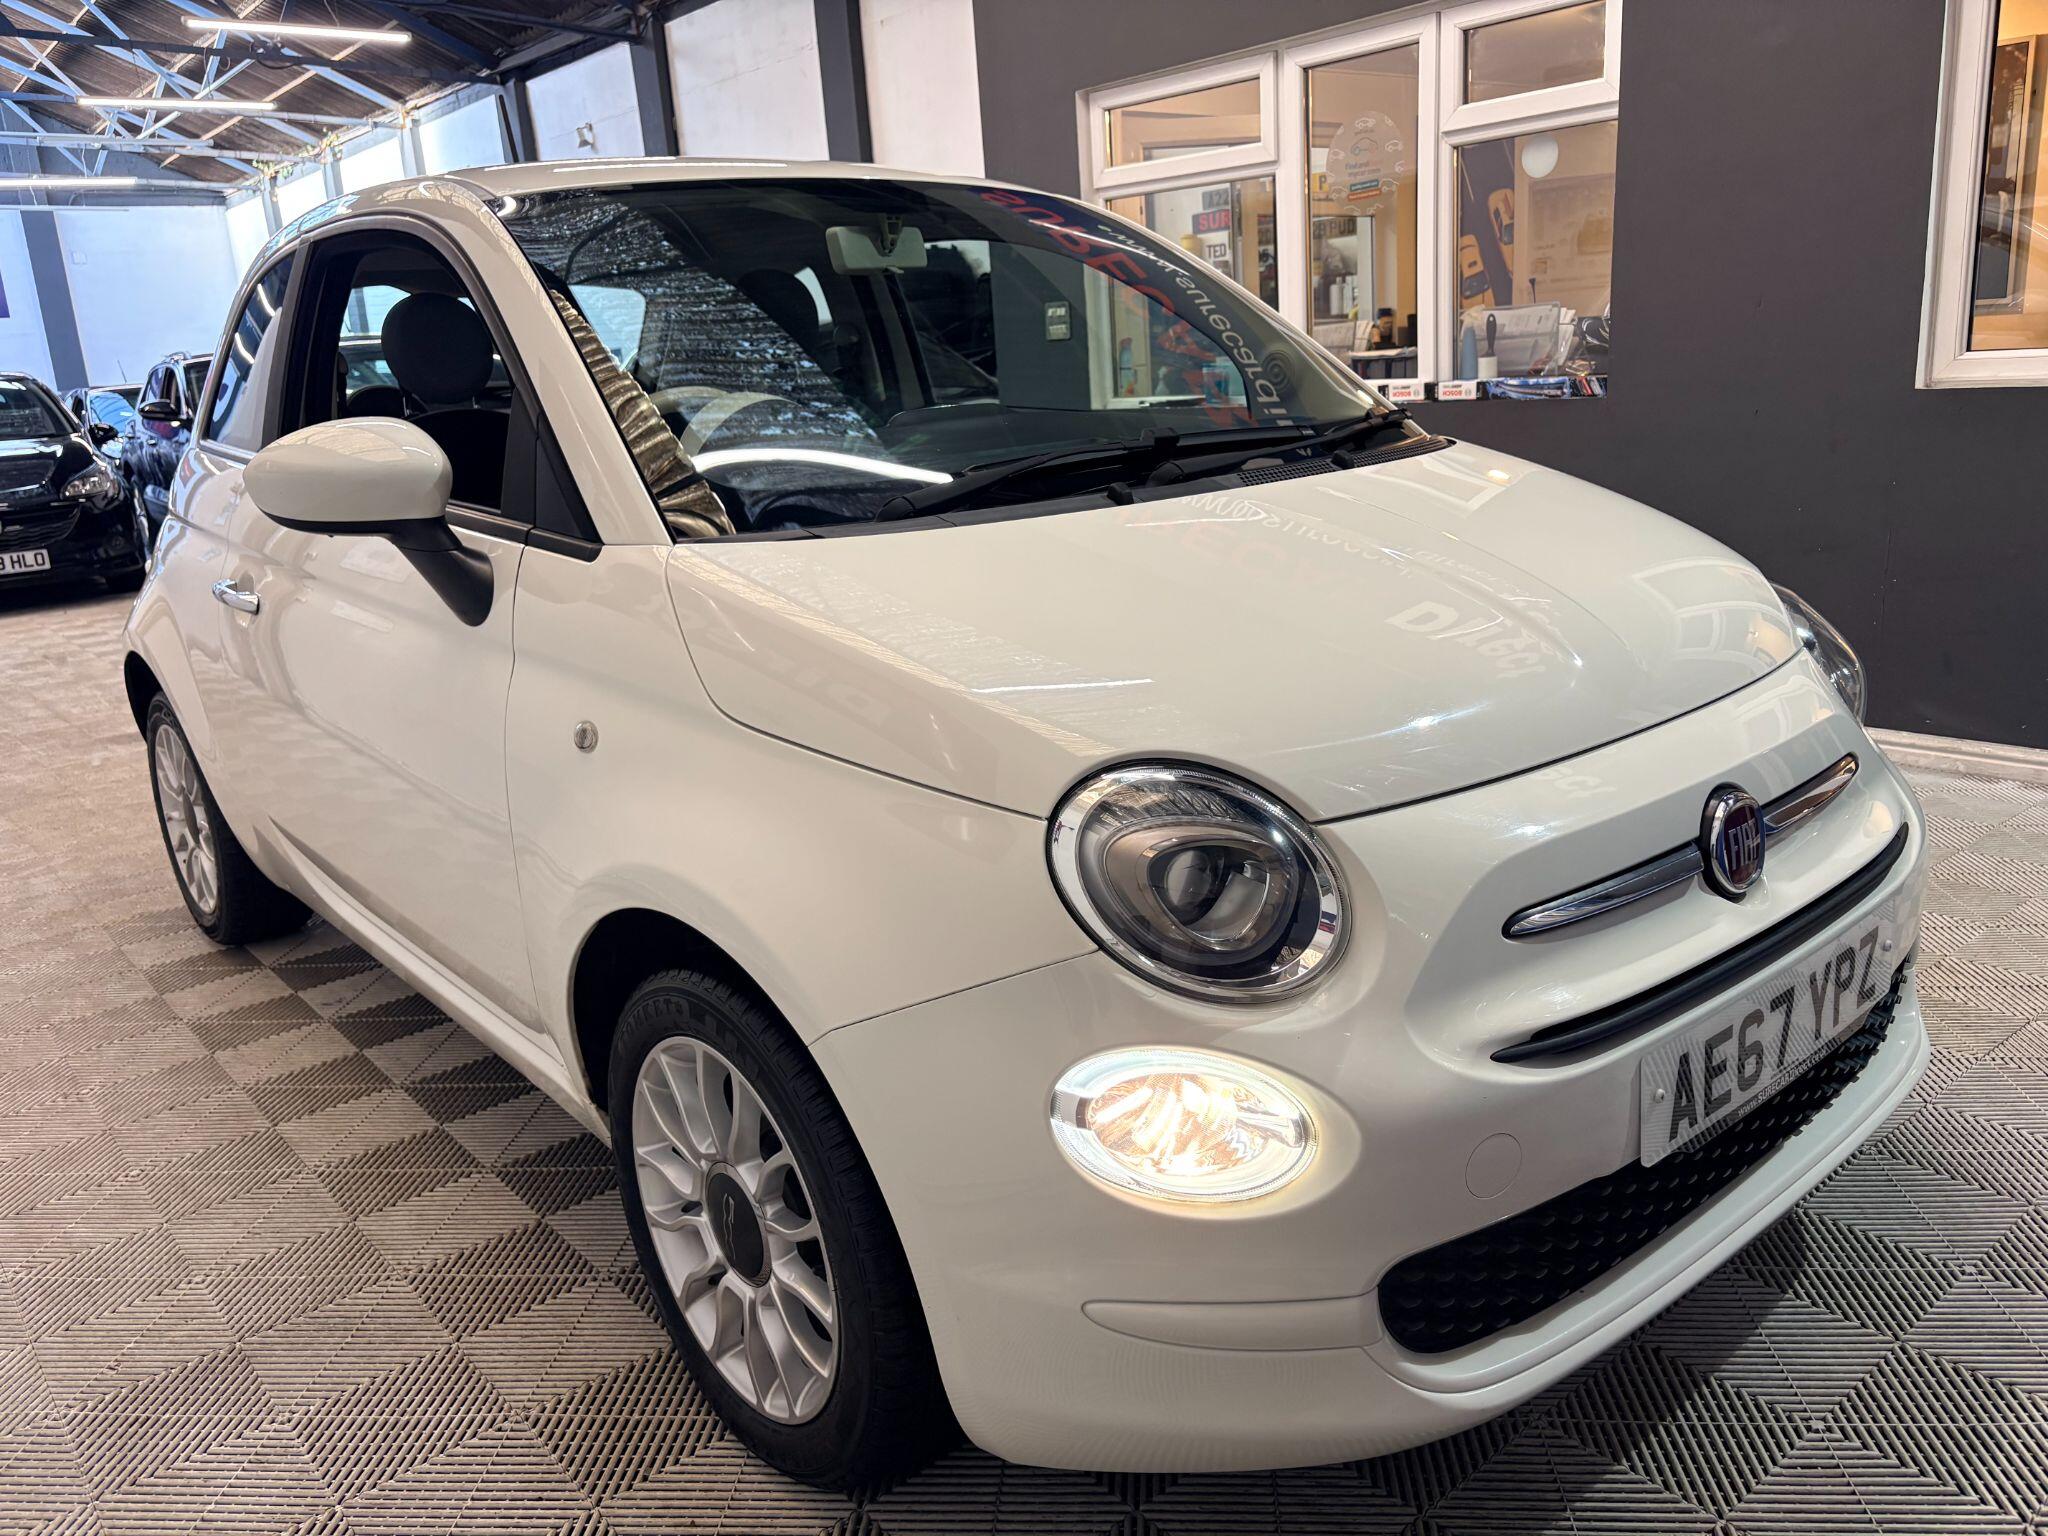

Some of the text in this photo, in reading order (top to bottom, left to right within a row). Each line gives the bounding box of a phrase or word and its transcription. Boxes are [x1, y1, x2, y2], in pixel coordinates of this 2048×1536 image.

[10, 552, 45, 569] HLO
[1728, 817, 1760, 871] FIAT
[1667, 925, 1880, 1144] AE67 YPZ
